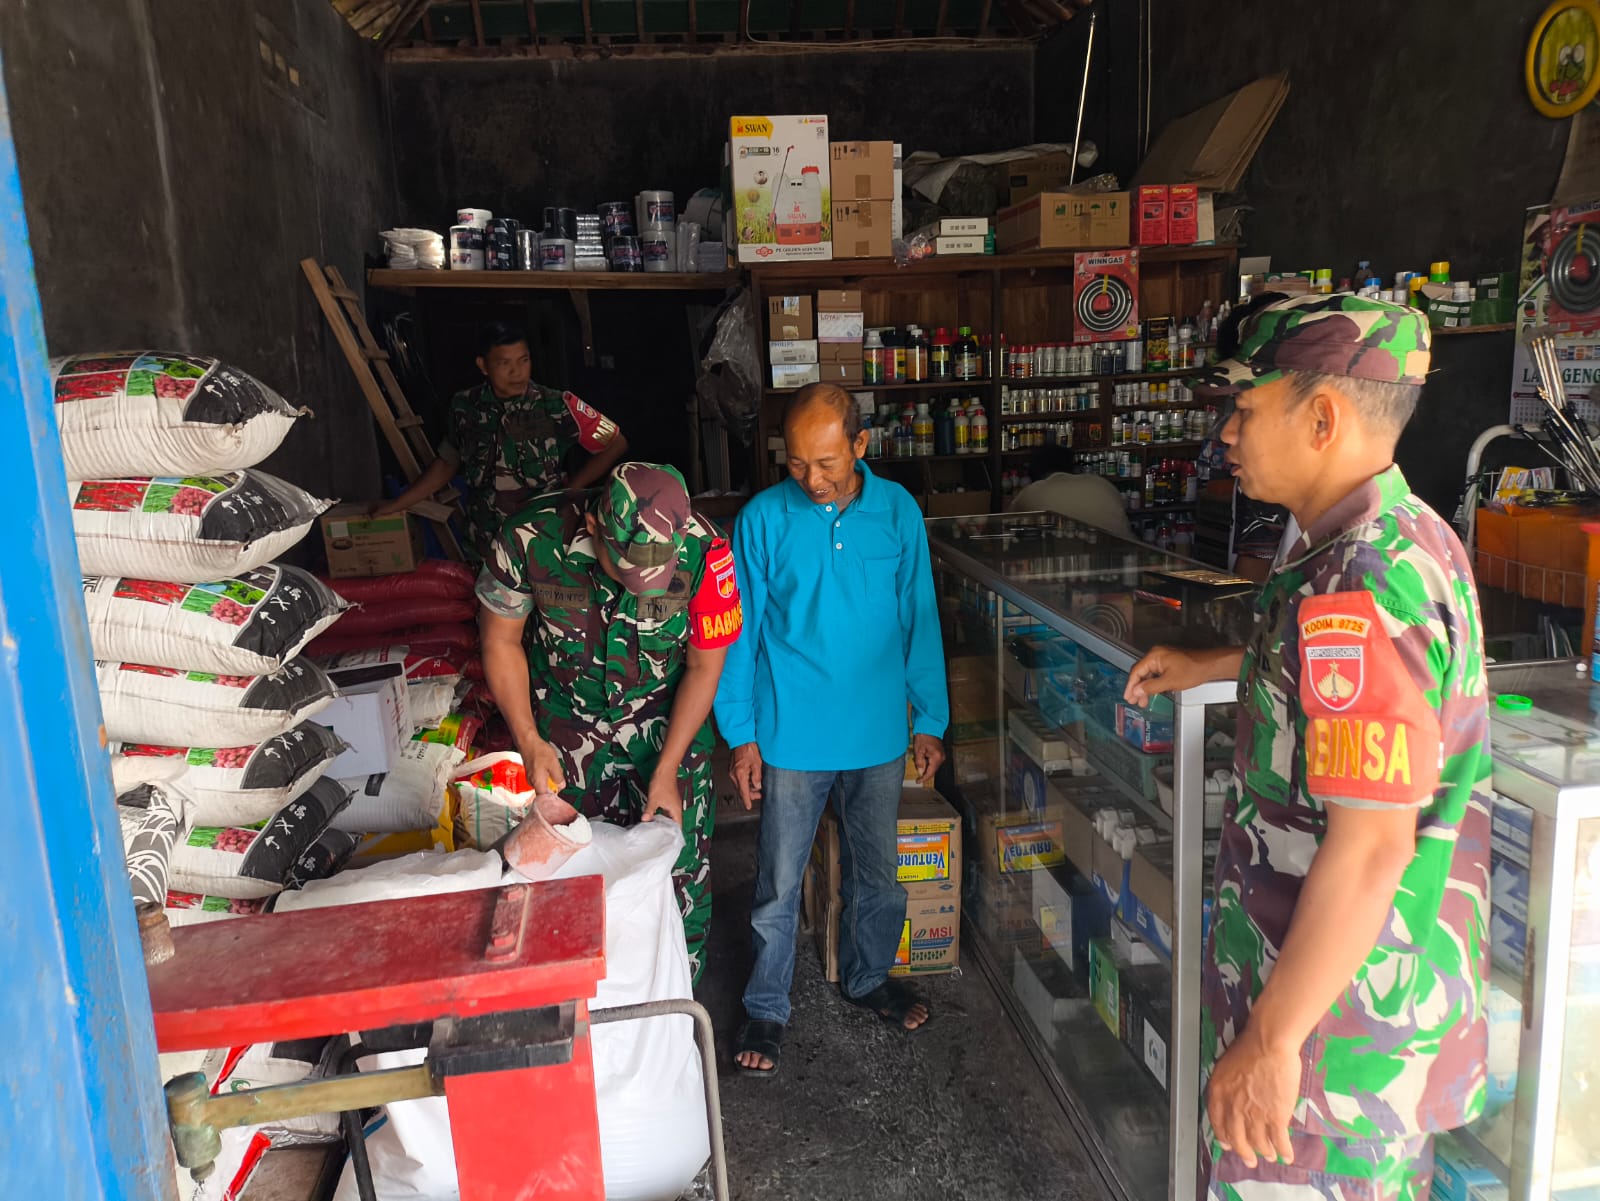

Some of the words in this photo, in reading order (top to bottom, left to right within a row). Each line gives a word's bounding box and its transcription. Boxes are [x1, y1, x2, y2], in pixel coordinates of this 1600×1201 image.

[744, 123, 768, 133] SWAN
[1523, 367, 1600, 384] LAGENG
[1303, 616, 1333, 636] KODIM
[929, 925, 952, 939] MSI
